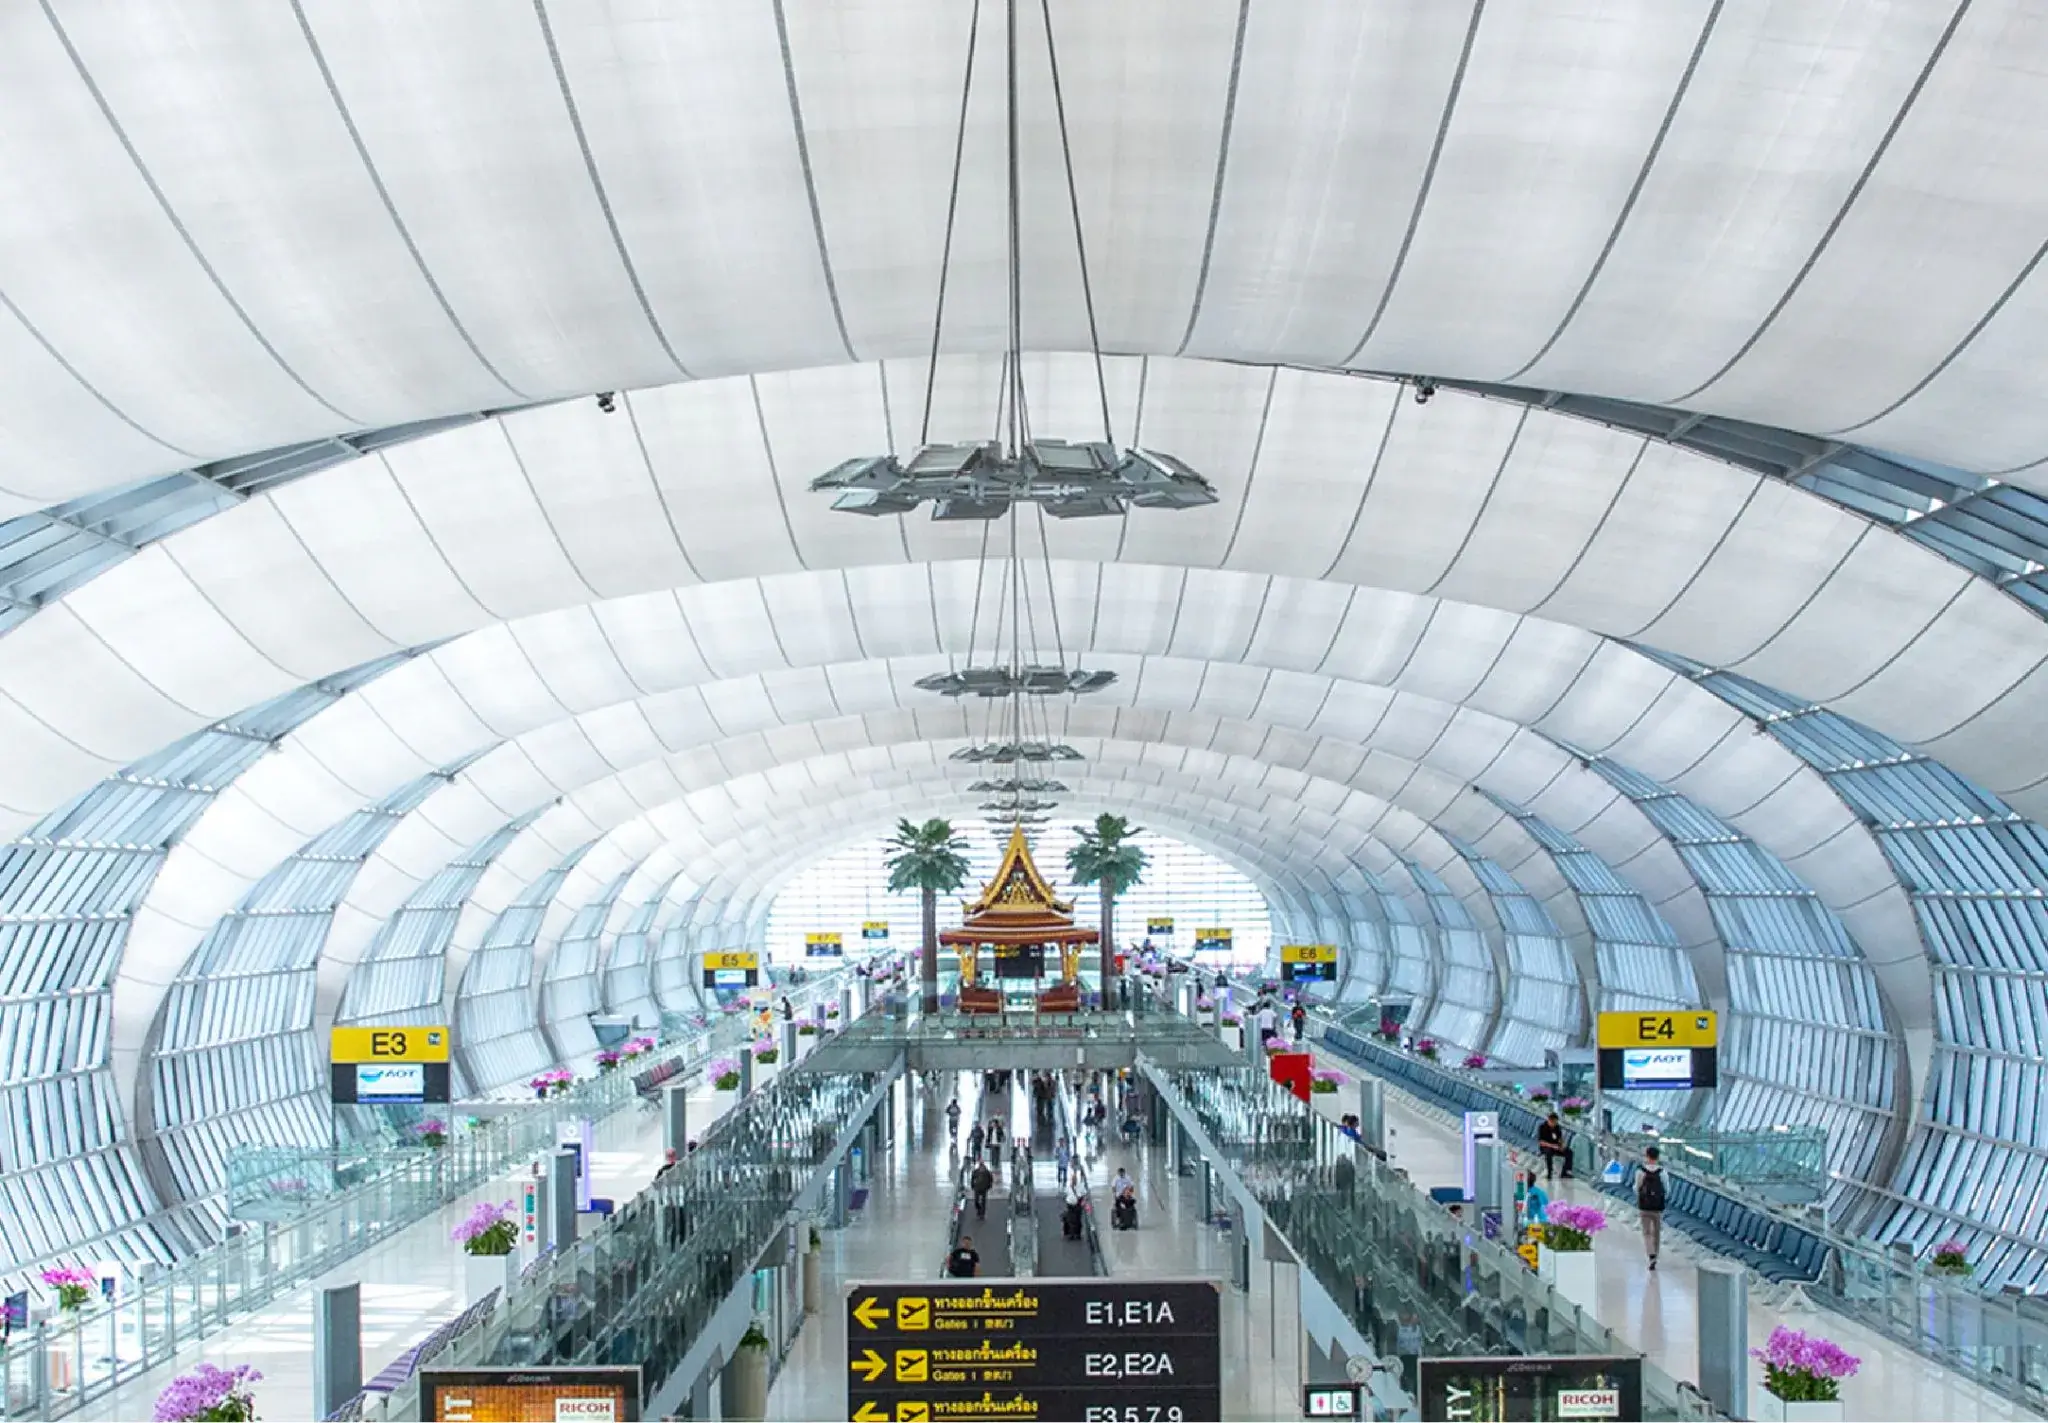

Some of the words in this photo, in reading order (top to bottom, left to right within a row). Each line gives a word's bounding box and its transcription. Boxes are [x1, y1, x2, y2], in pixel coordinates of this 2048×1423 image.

[721, 953, 738, 967] E5
[1639, 1016, 1675, 1040] E4
[371, 1032, 407, 1056] E3
[934, 1318, 968, 1330] Gates
[1085, 1301, 1175, 1328] E1,E1A
[1085, 1352, 1175, 1380] E2,E2A
[560, 1402, 610, 1413] RICOH
[1562, 1394, 1613, 1404] RICOH
